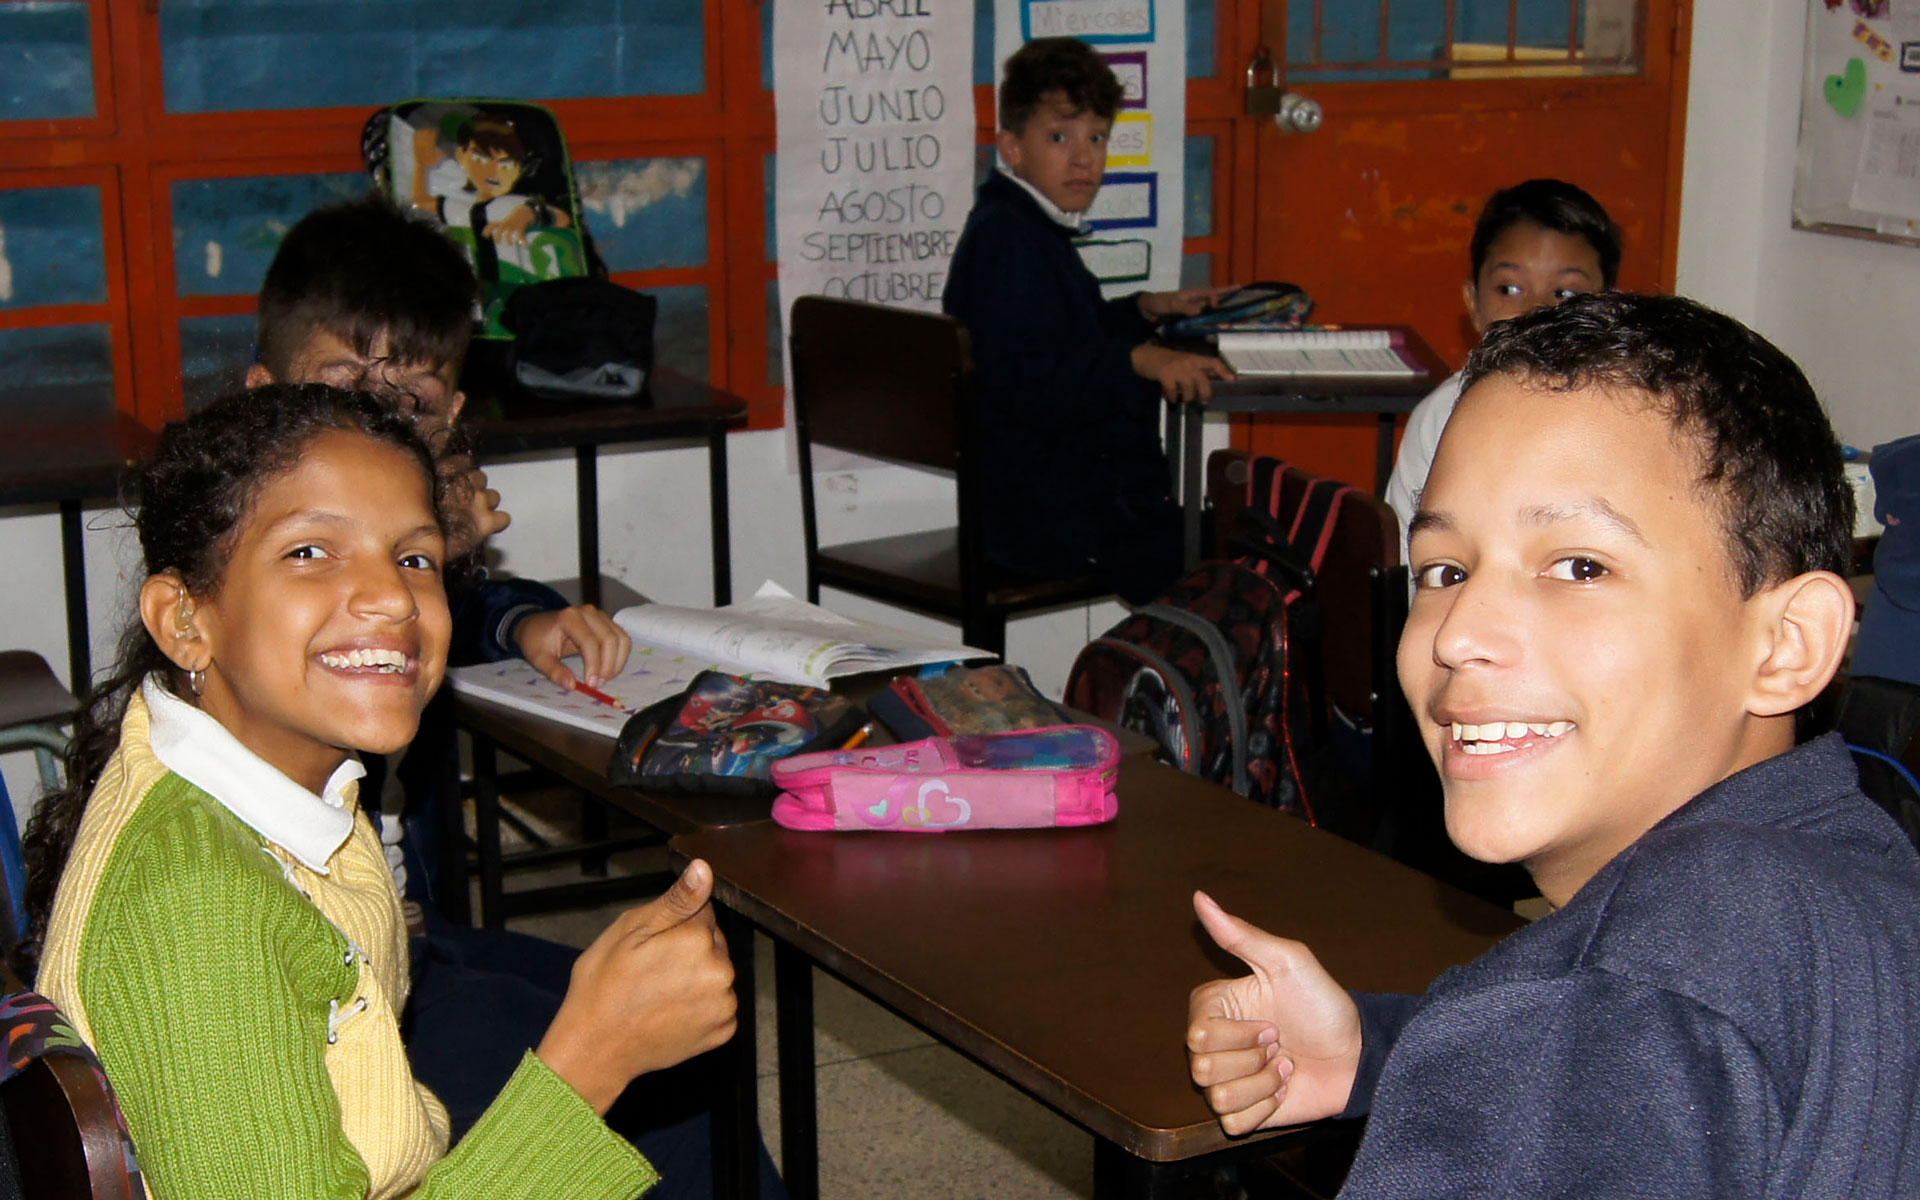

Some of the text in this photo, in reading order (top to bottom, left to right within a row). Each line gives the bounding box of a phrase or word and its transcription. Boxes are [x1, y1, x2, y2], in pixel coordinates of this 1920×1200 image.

[823, 29, 930, 73] MAYO
[820, 85, 944, 126] JUNIO
[821, 134, 940, 174] JULIO
[818, 183, 944, 223] AGOSTO
[800, 230, 956, 263] SEPTIEMBRE
[823, 270, 944, 302] OCTUBRE
